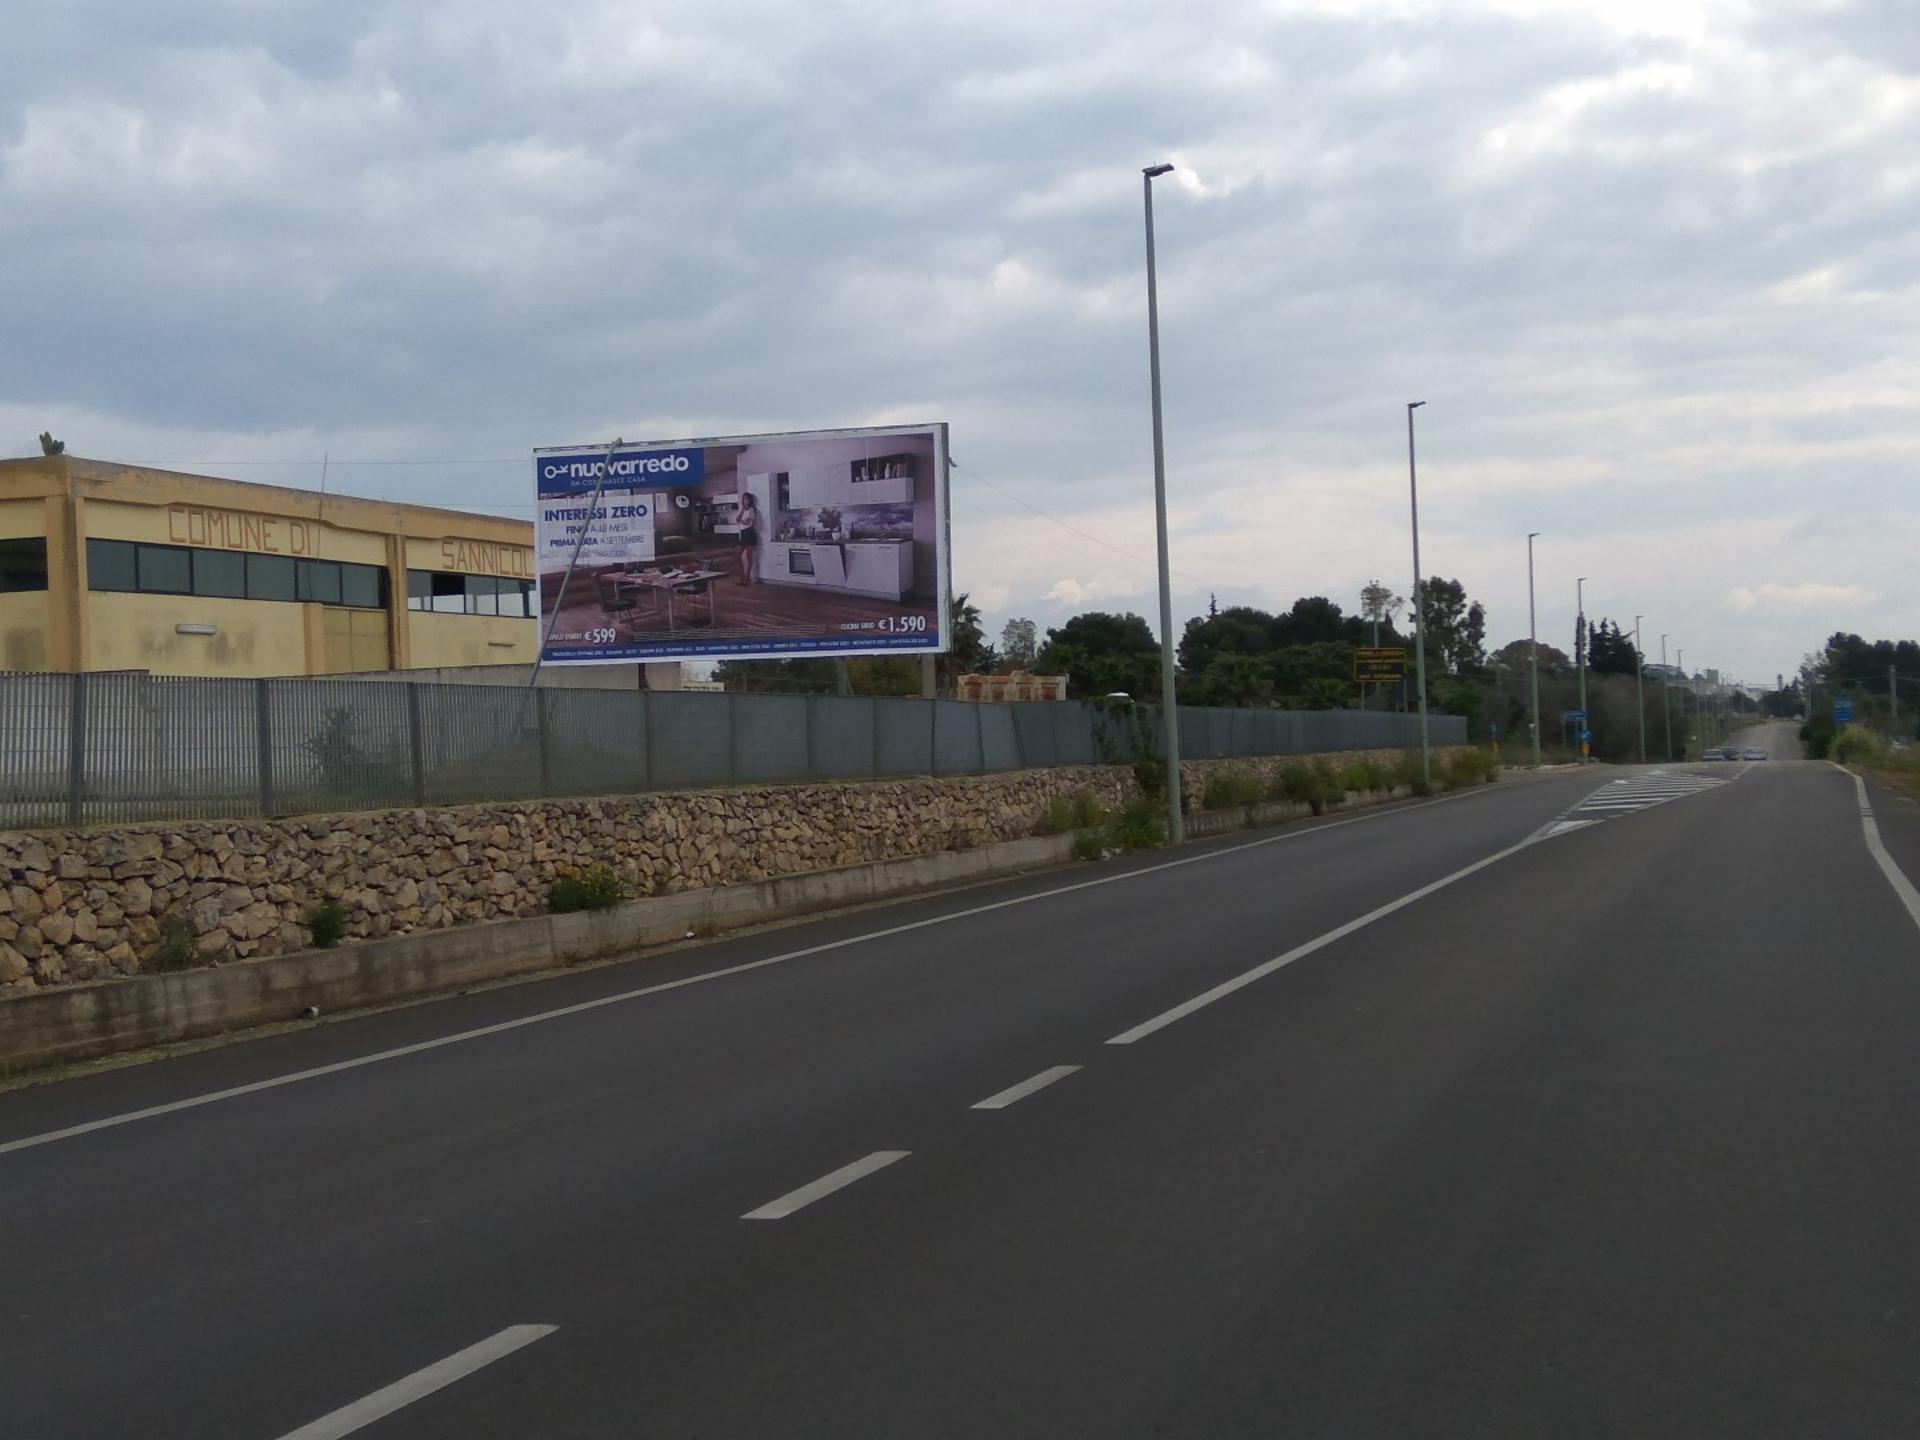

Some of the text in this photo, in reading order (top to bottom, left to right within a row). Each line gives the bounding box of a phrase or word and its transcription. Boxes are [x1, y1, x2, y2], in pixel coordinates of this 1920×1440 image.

[570, 454, 689, 478] nuovarredo
[627, 475, 646, 484] CASA
[544, 504, 648, 522] INTERESSI ZERO
[168, 505, 312, 555] COMUNE DI
[550, 537, 576, 547] PRIMA
[577, 536, 599, 546] ATA
[606, 535, 645, 545] SETTEMBRE
[442, 541, 535, 577] SANNICOL
